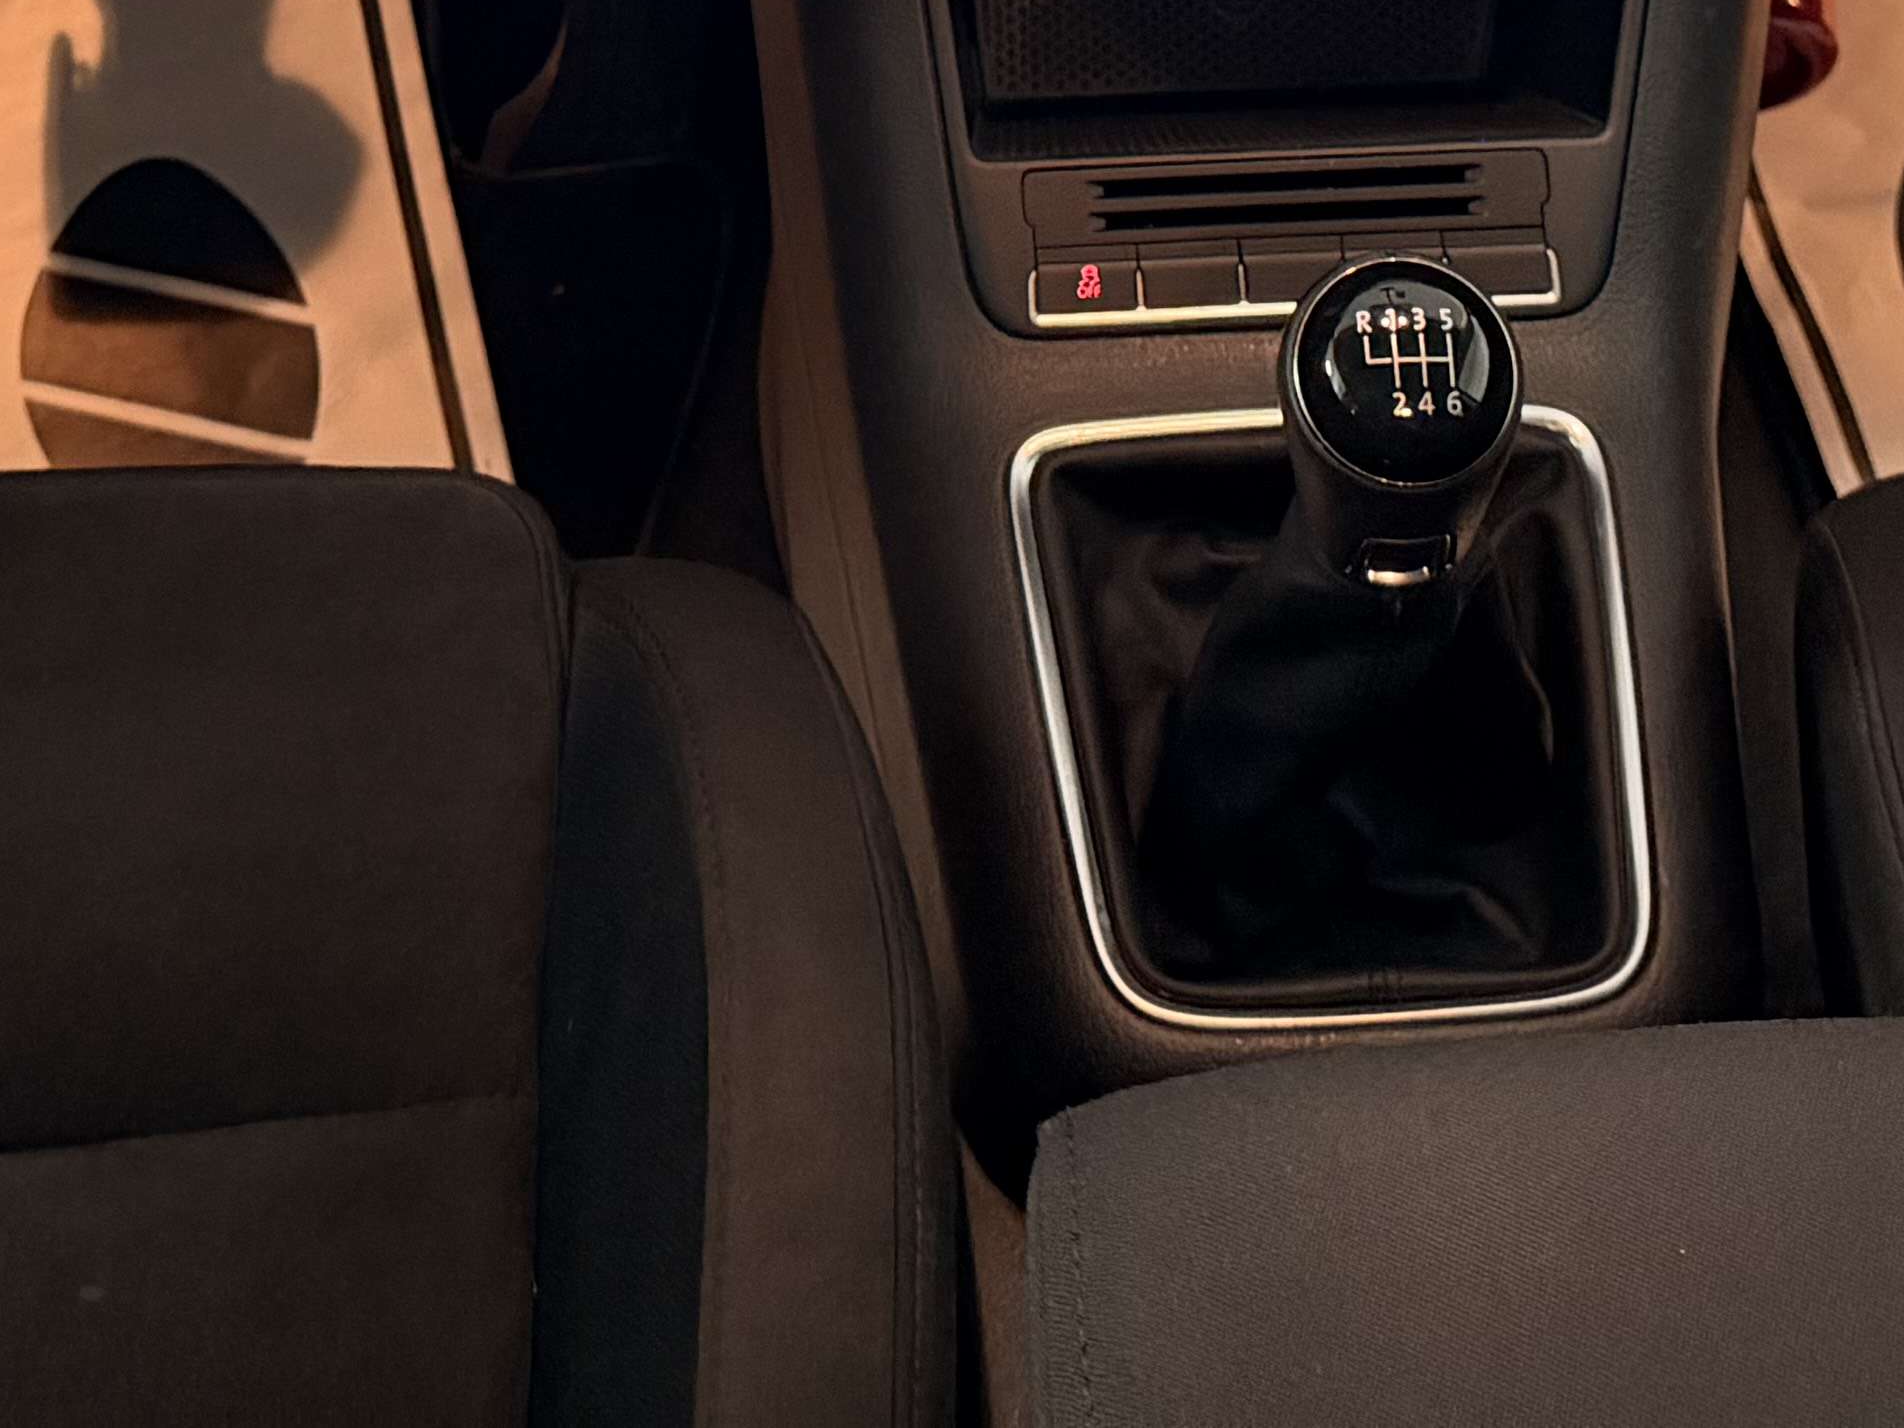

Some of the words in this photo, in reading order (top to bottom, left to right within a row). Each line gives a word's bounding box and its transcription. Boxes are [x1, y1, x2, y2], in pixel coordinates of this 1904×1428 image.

[1355, 309, 1373, 334] R
[1410, 306, 1427, 332] 3
[1438, 307, 1454, 332] 5
[1392, 391, 1409, 417] 2
[1417, 390, 1436, 416] 4
[1446, 390, 1464, 417] 6
